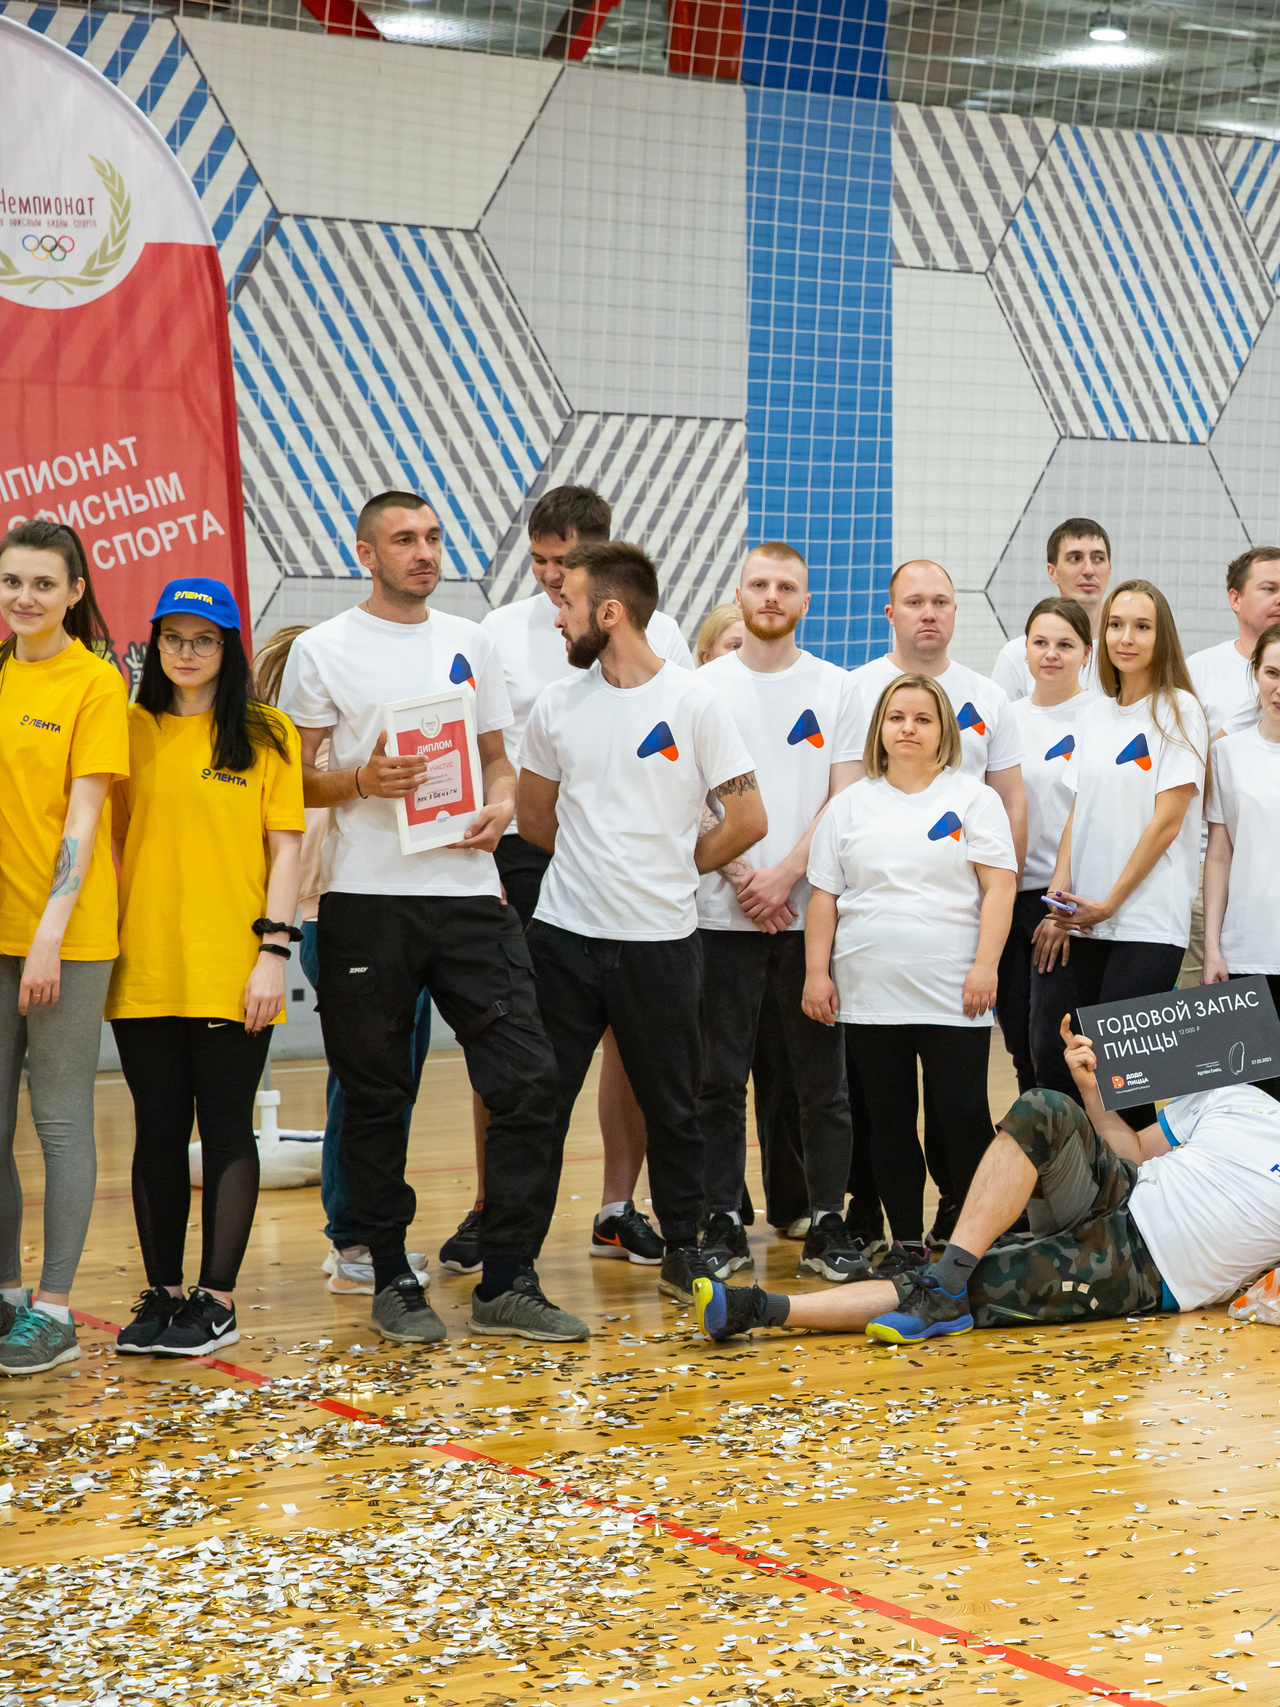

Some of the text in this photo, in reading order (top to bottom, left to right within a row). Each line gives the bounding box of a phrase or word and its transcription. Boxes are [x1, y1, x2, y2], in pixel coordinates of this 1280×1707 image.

[92, 509, 226, 570] СПОРТА
[180, 590, 213, 606] ЛЕНТА
[29, 718, 61, 734] ЛЕНТА
[417, 739, 453, 756] ДИПЛОМ
[213, 773, 247, 788] ЛЕНТА
[1097, 991, 1259, 1036] ГОДОВОЙ ЗАПАС
[1103, 1030, 1178, 1060] ПИЦЦЫ
